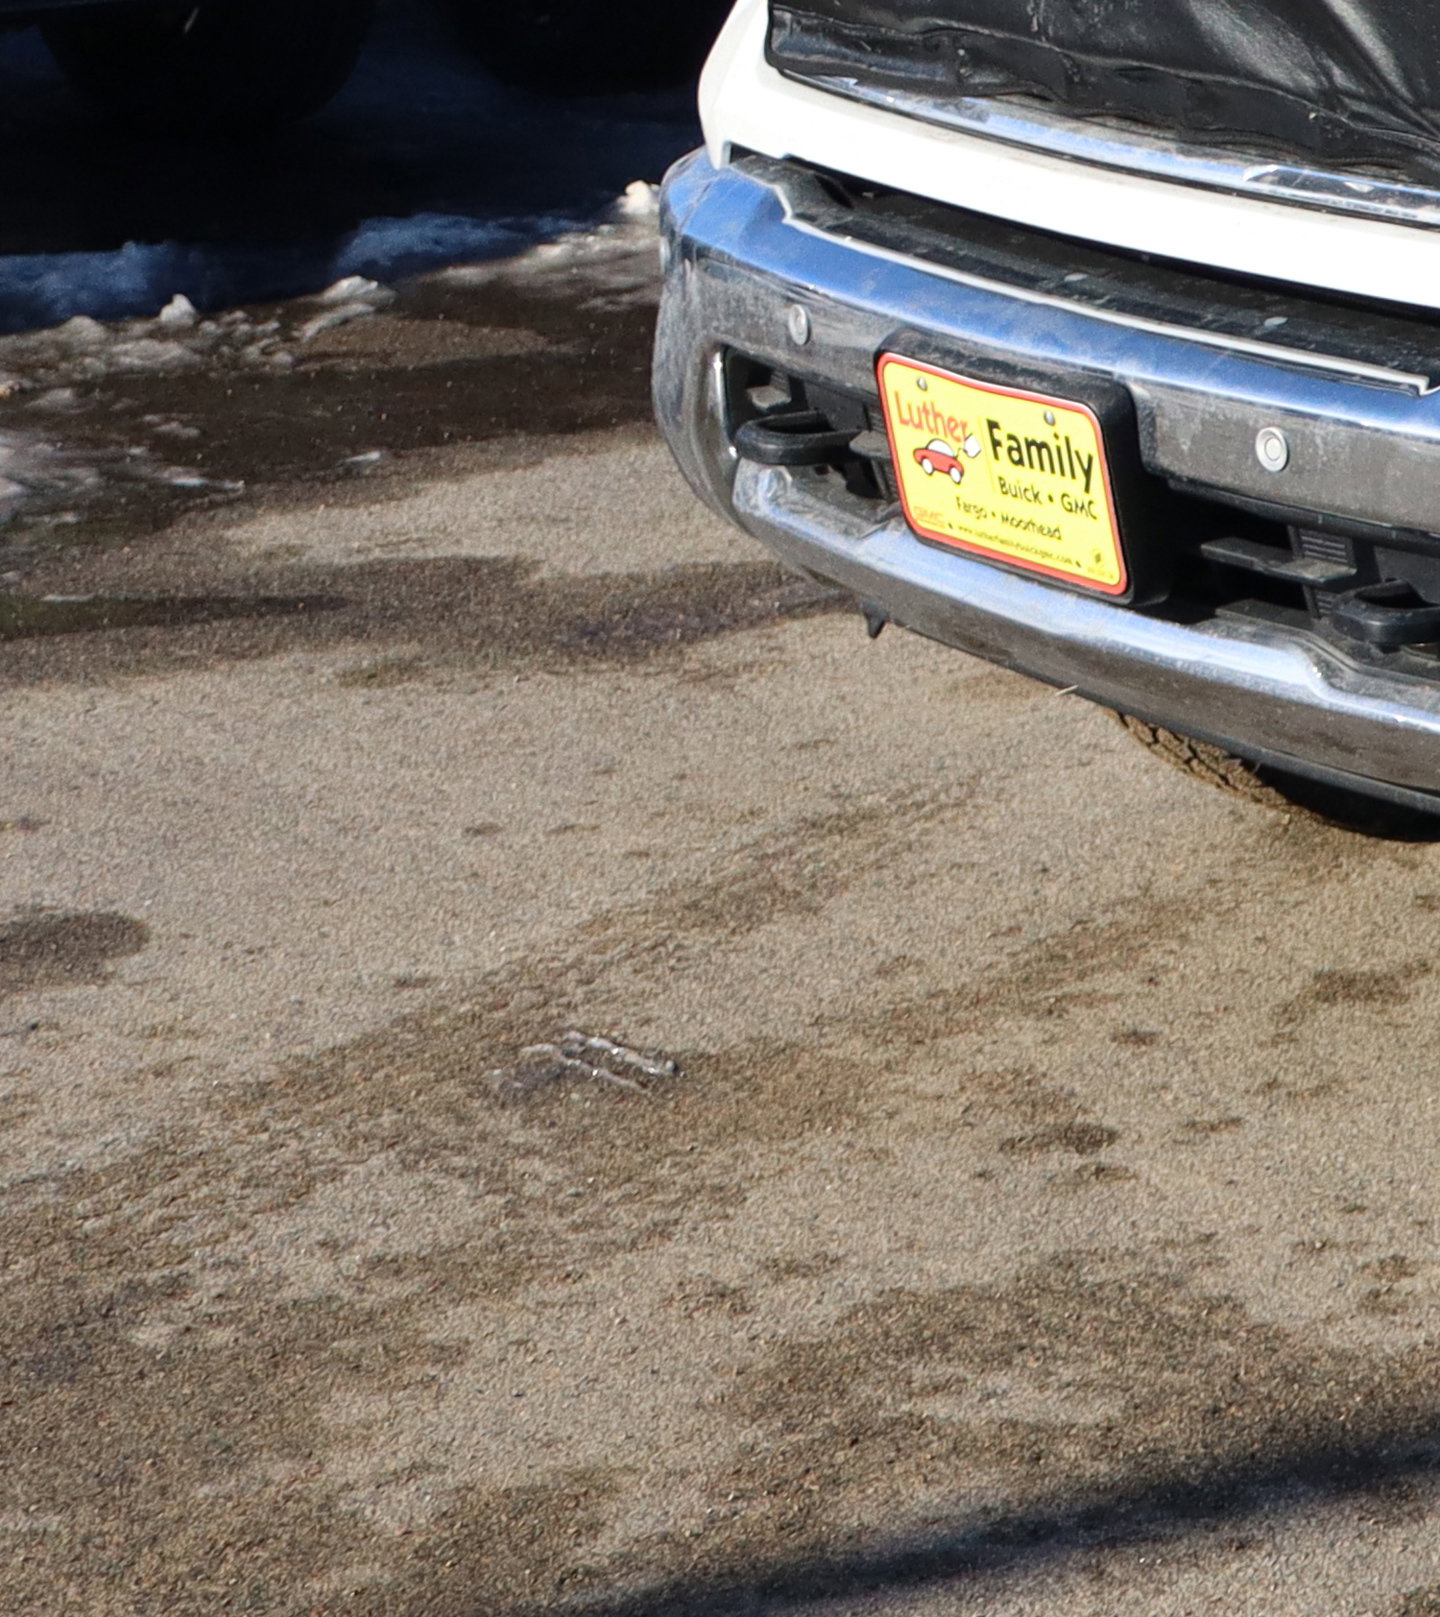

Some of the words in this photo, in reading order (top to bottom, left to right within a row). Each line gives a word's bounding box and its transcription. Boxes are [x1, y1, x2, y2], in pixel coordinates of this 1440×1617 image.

[895, 390, 968, 443] Luther
[986, 418, 1094, 494] Family
[955, 496, 988, 520] Fargo
[1000, 512, 1062, 541] Moorhead
[998, 476, 1044, 506] Buick
[1060, 493, 1098, 520] GMC
